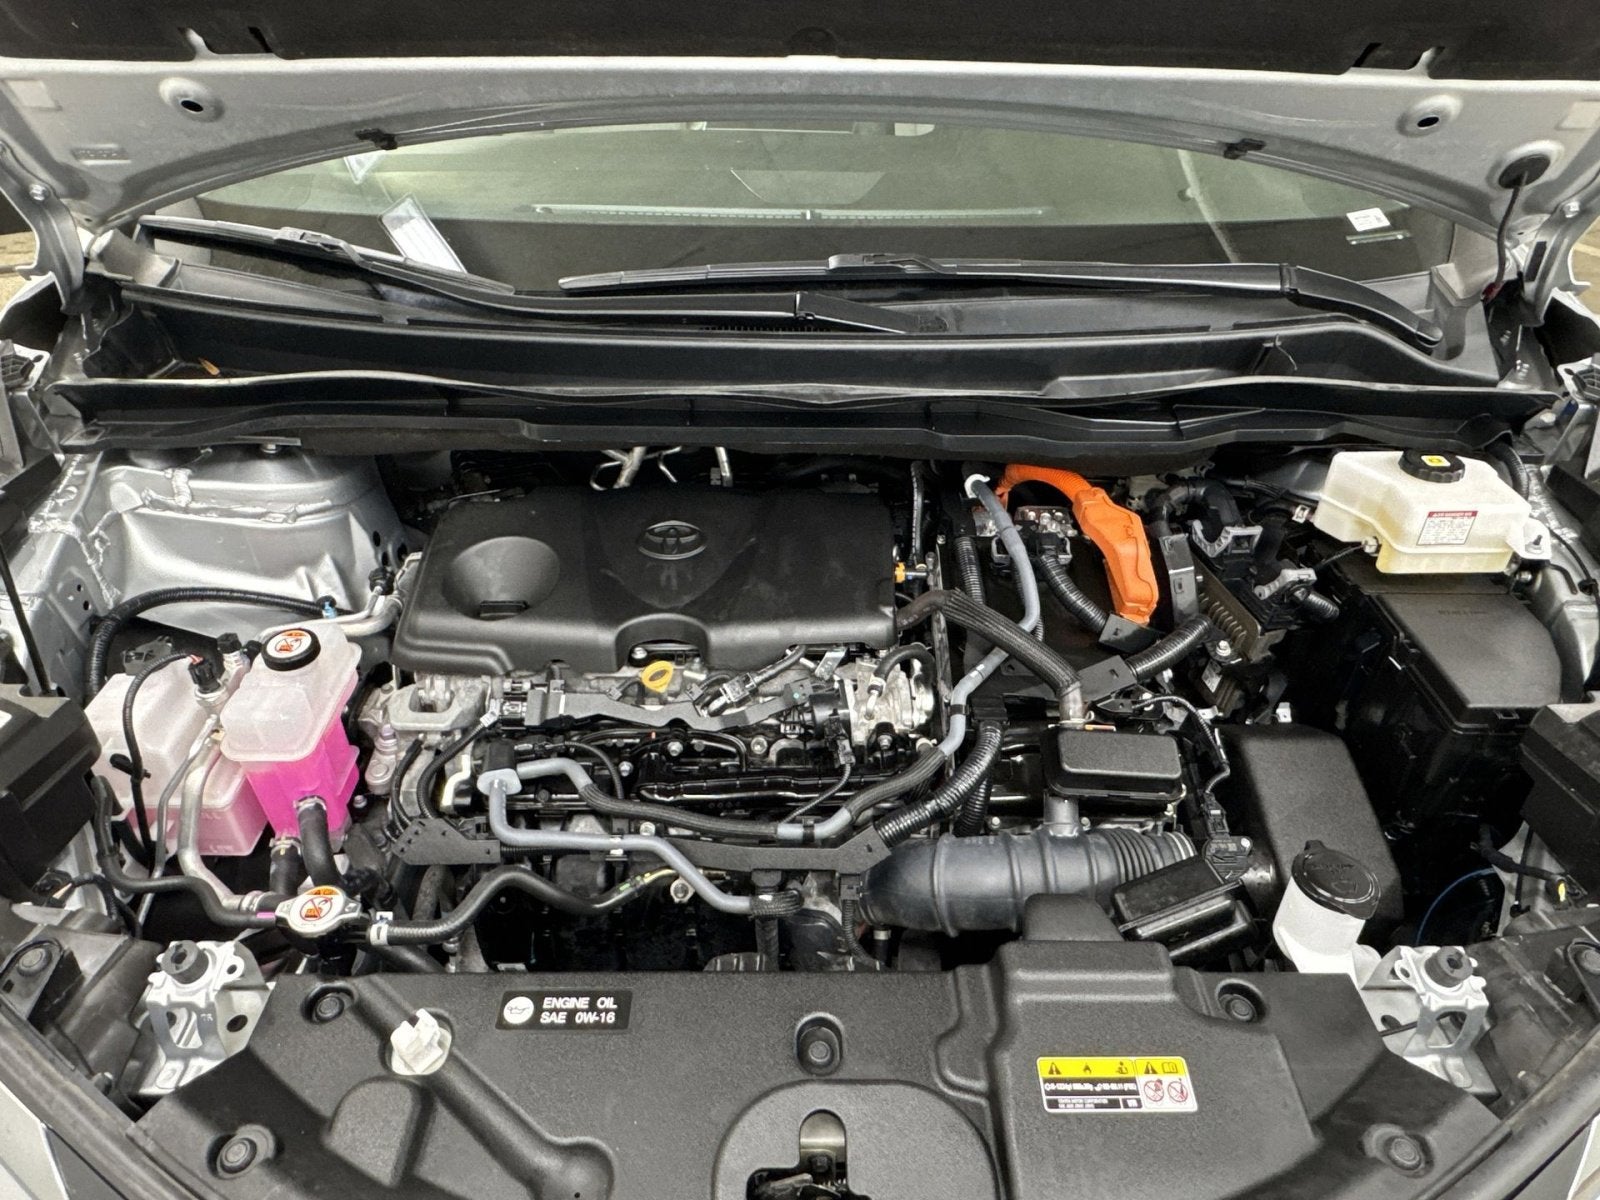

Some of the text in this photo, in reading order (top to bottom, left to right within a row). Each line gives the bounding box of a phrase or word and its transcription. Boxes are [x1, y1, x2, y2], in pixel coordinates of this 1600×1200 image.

[542, 997, 618, 1009] ENGINE OIL
[540, 1012, 616, 1024] SAE 0W-16
